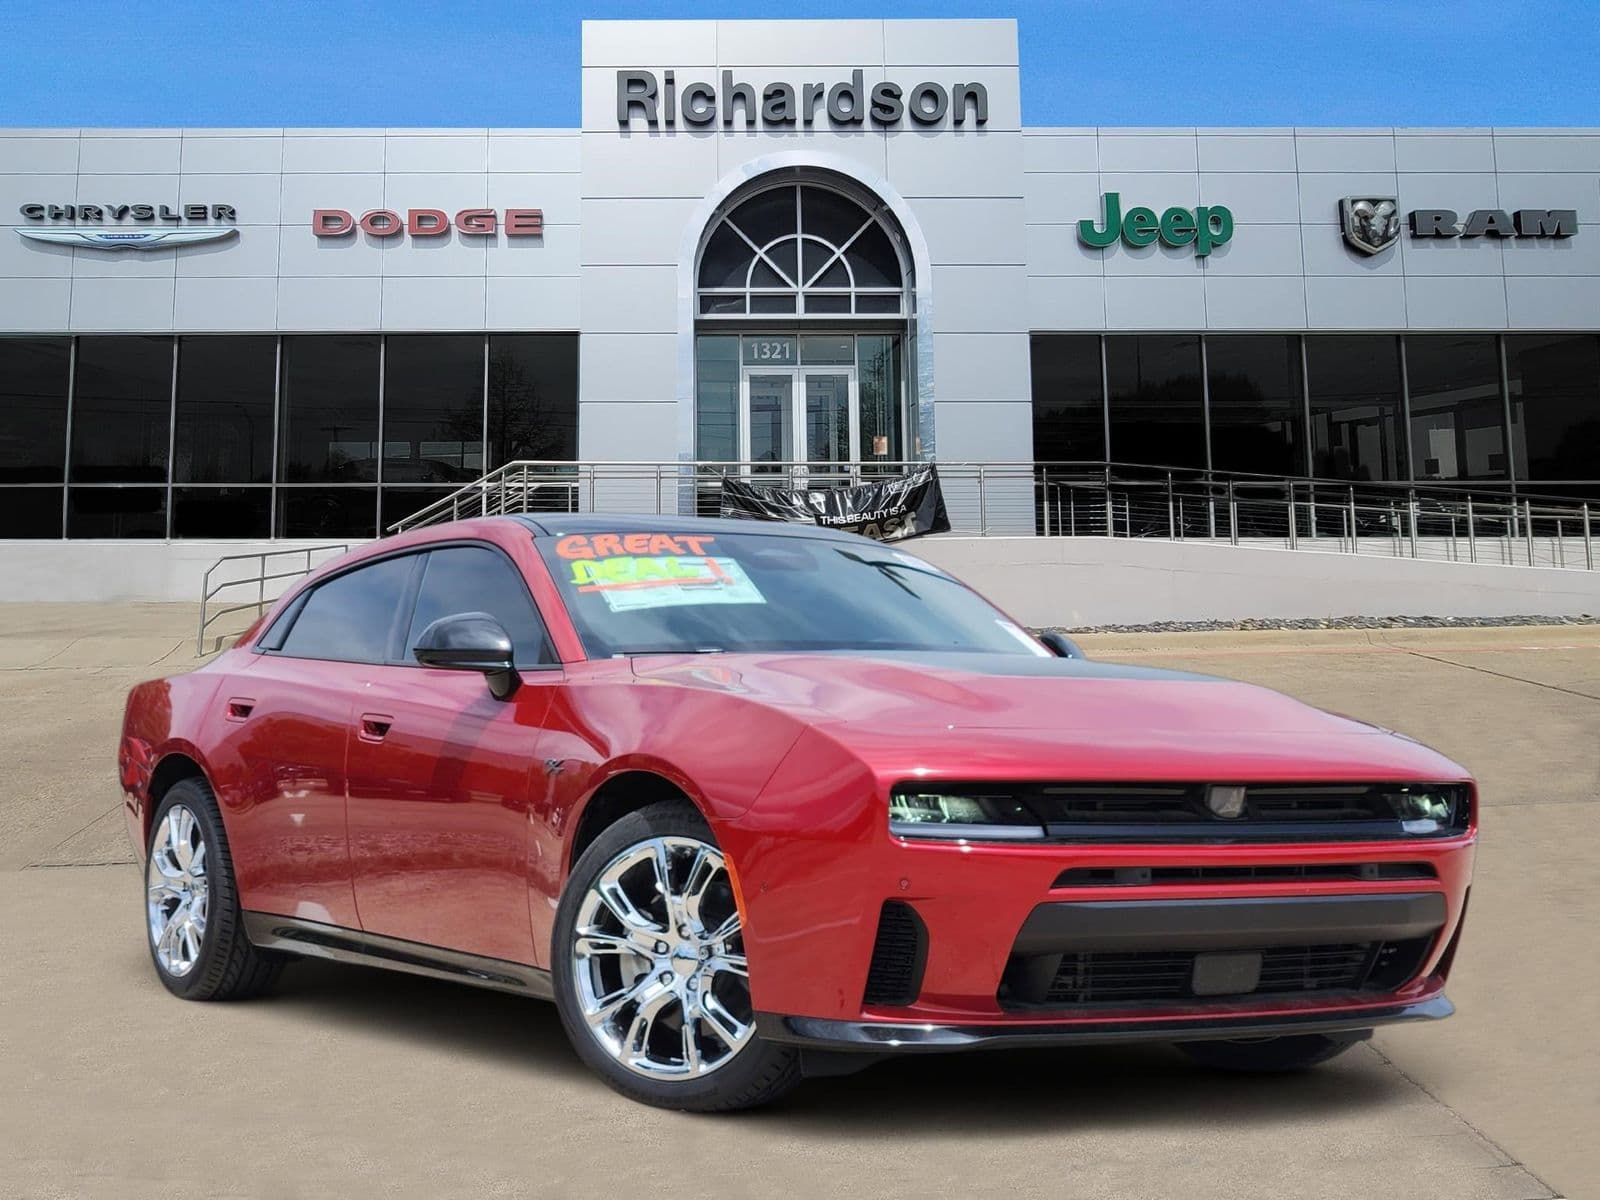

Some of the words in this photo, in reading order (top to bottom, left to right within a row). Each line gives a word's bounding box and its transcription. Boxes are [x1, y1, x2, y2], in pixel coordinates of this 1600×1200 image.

[616, 69, 988, 126] Richardson
[19, 203, 237, 221] CHRYSLER
[312, 208, 544, 237] DODGE
[1077, 192, 1234, 257] Jeep
[1410, 209, 1577, 239] RAM
[751, 342, 791, 359] 1321
[820, 516, 846, 525] THIS
[846, 508, 888, 523] BEAUTY
[889, 506, 899, 516] IS
[900, 504, 907, 513] A
[556, 533, 715, 560] GREAT
